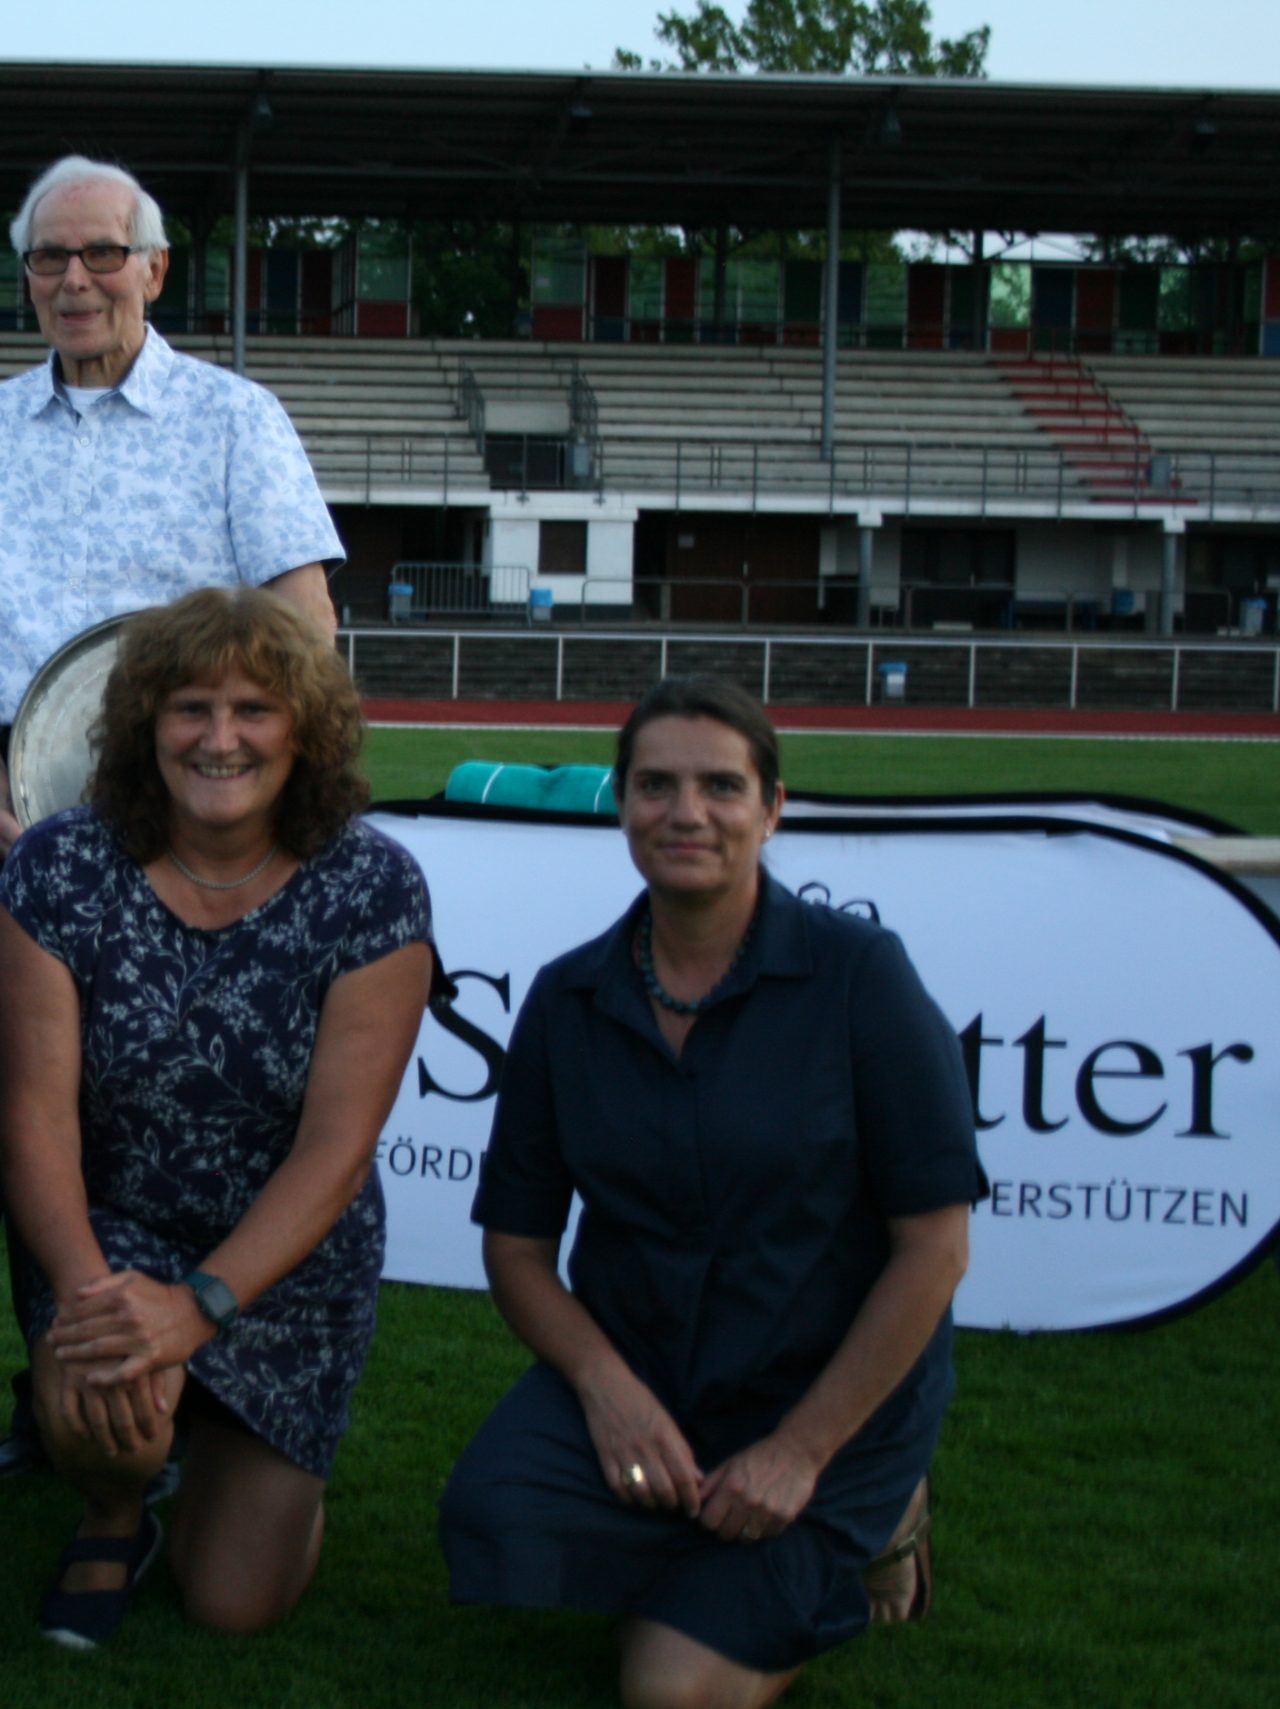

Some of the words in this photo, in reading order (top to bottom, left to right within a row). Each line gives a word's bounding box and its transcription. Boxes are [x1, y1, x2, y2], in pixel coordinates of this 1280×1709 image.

[418, 970, 510, 1103] S
[958, 1011, 1255, 1140] tter
[375, 1136, 488, 1182] ÖRD
[971, 1178, 1249, 1228] ERSTÜTZEN
